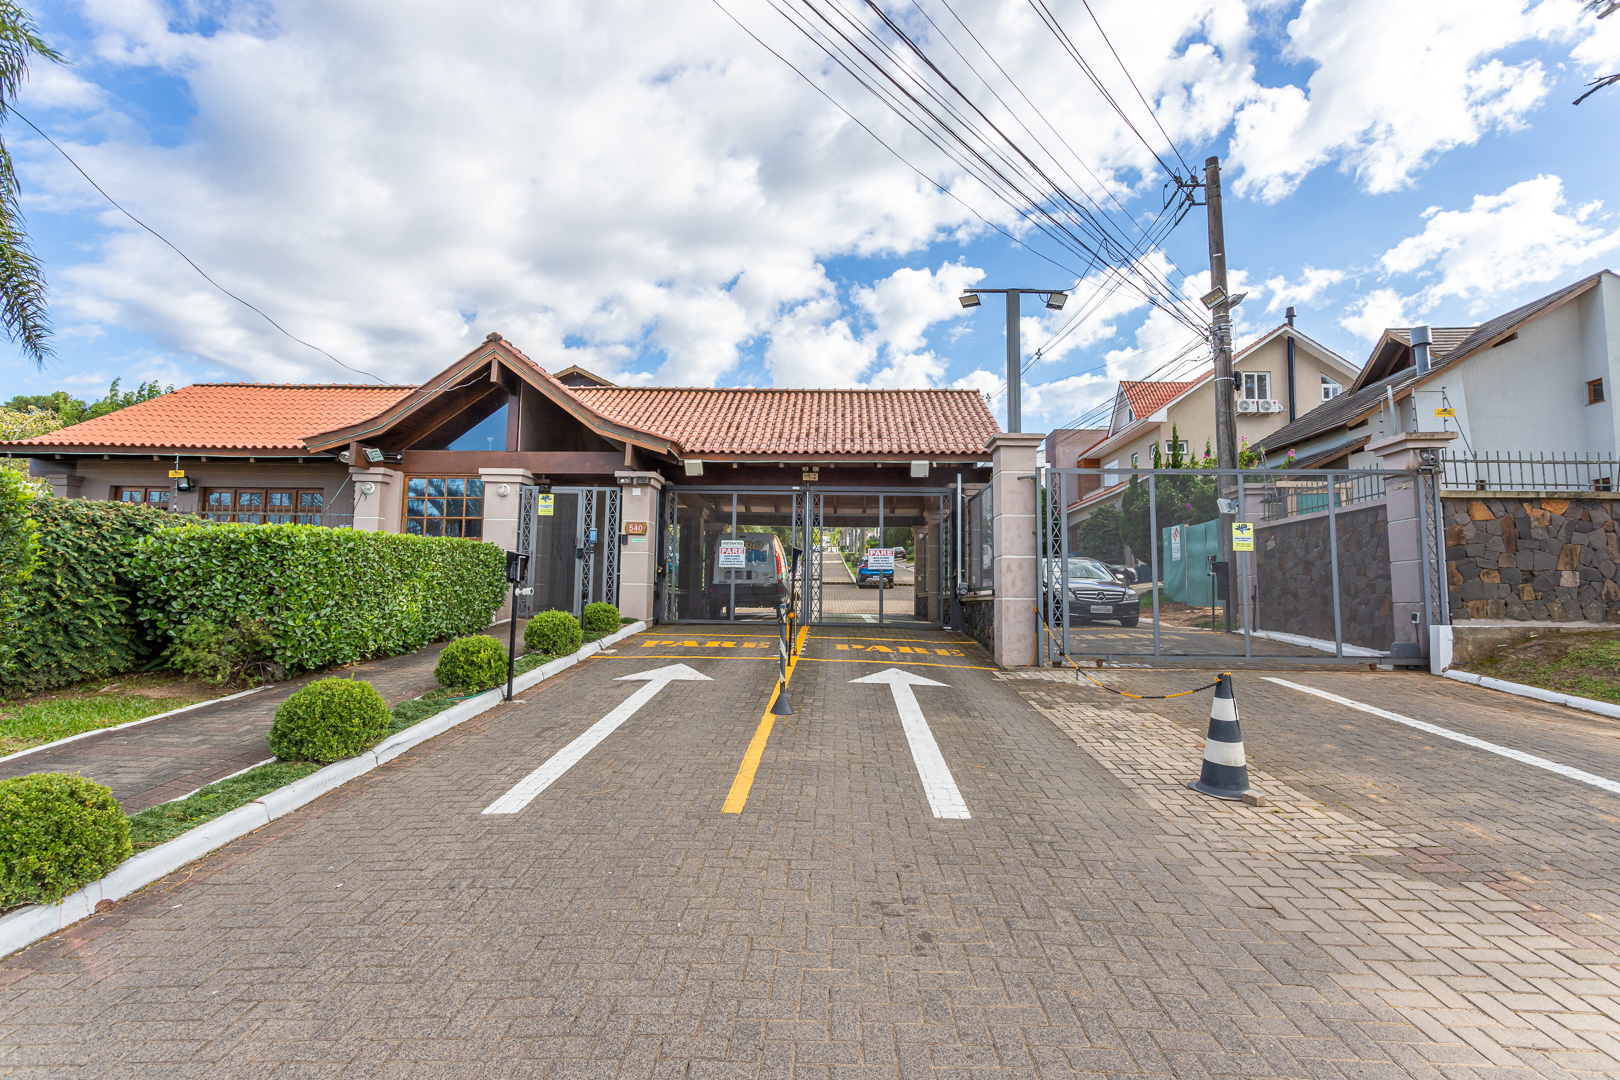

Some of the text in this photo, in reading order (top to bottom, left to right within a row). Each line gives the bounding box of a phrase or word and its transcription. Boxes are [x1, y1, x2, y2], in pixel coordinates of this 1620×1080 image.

[628, 524, 643, 532] 540
[638, 640, 771, 649] PARE
[834, 644, 965, 657] PARE
